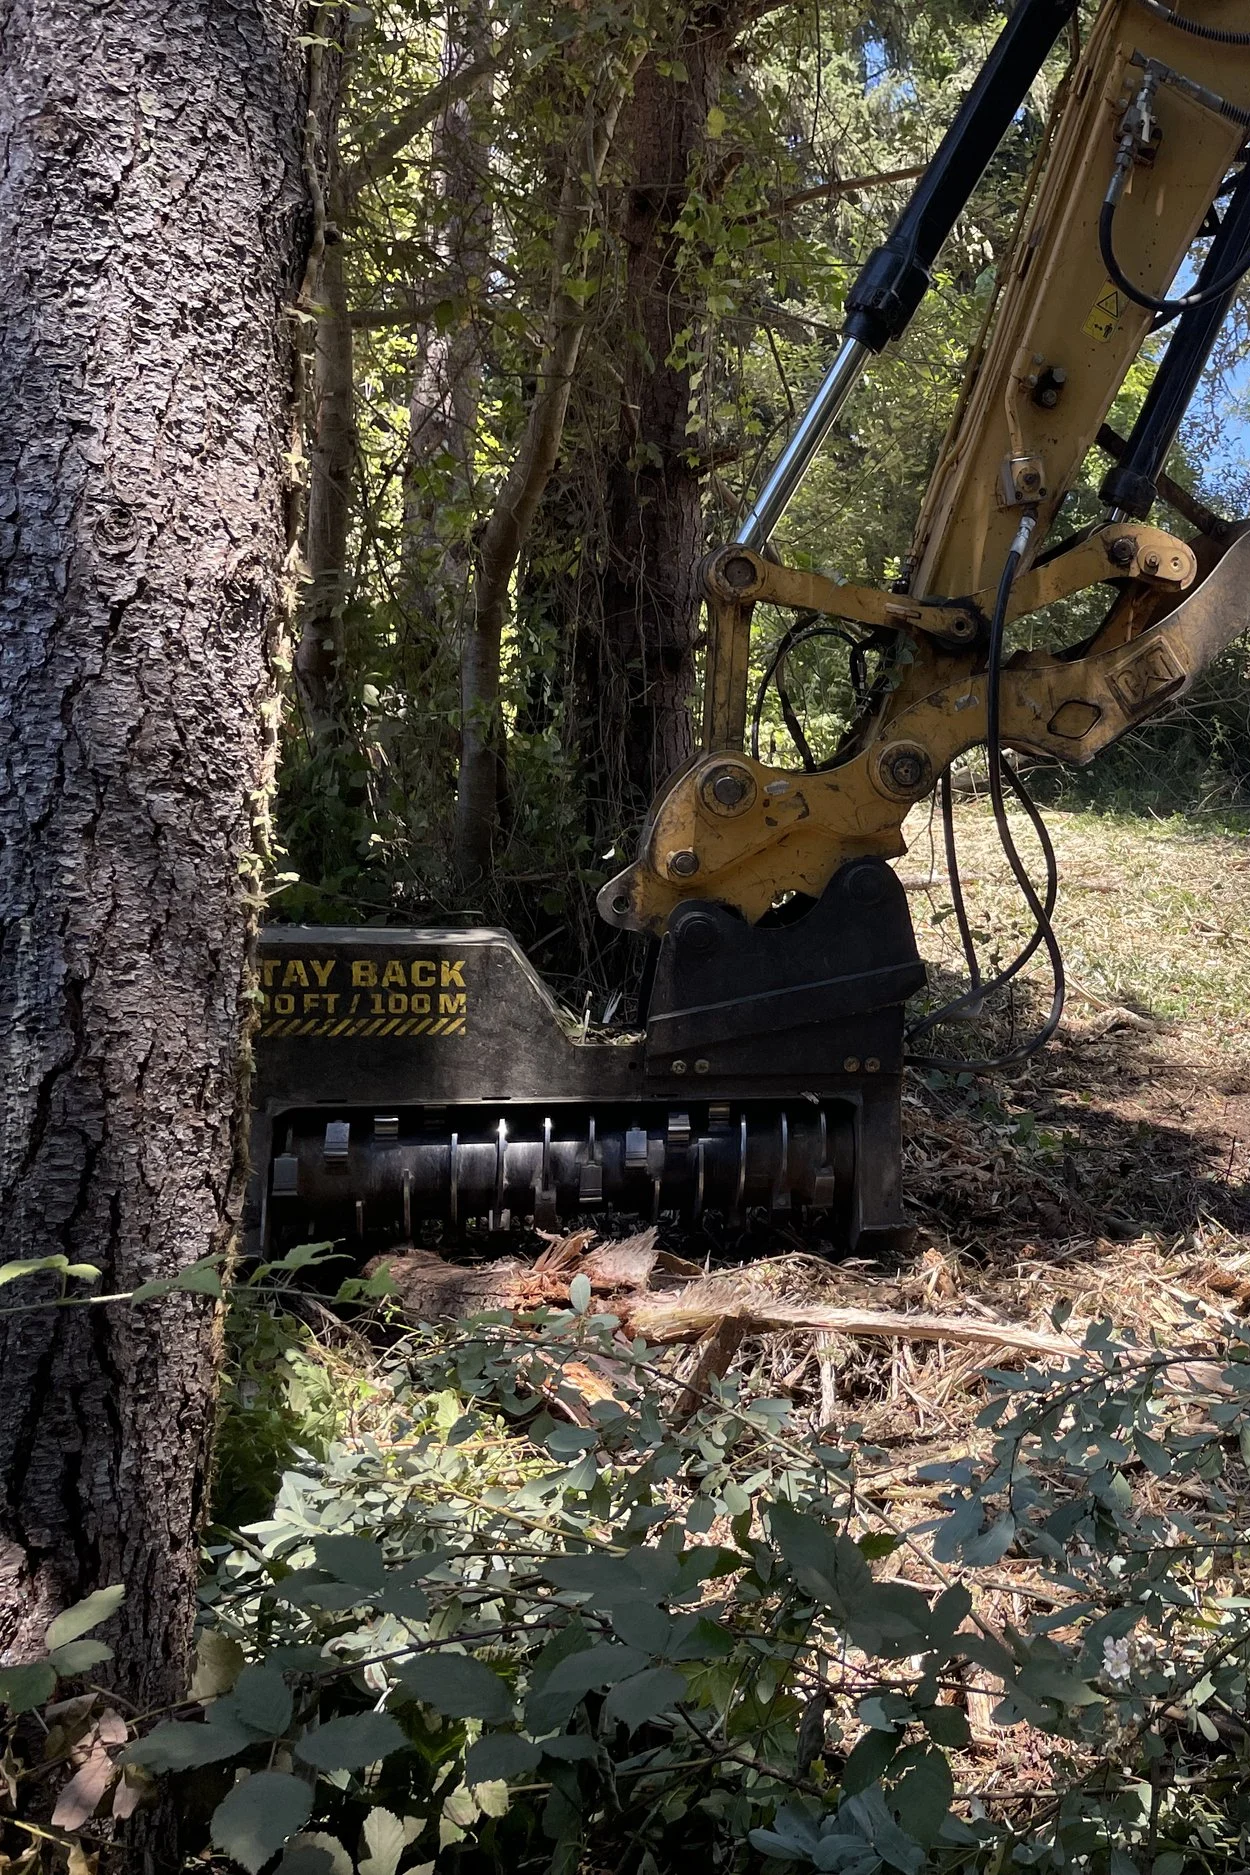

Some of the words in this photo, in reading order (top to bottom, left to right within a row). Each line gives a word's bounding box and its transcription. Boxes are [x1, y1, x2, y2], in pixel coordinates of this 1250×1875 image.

[257, 959, 336, 987] TAY
[352, 960, 466, 987] BACK
[303, 993, 341, 1014] FT
[370, 993, 431, 1014] 100
[438, 993, 467, 1014] M
